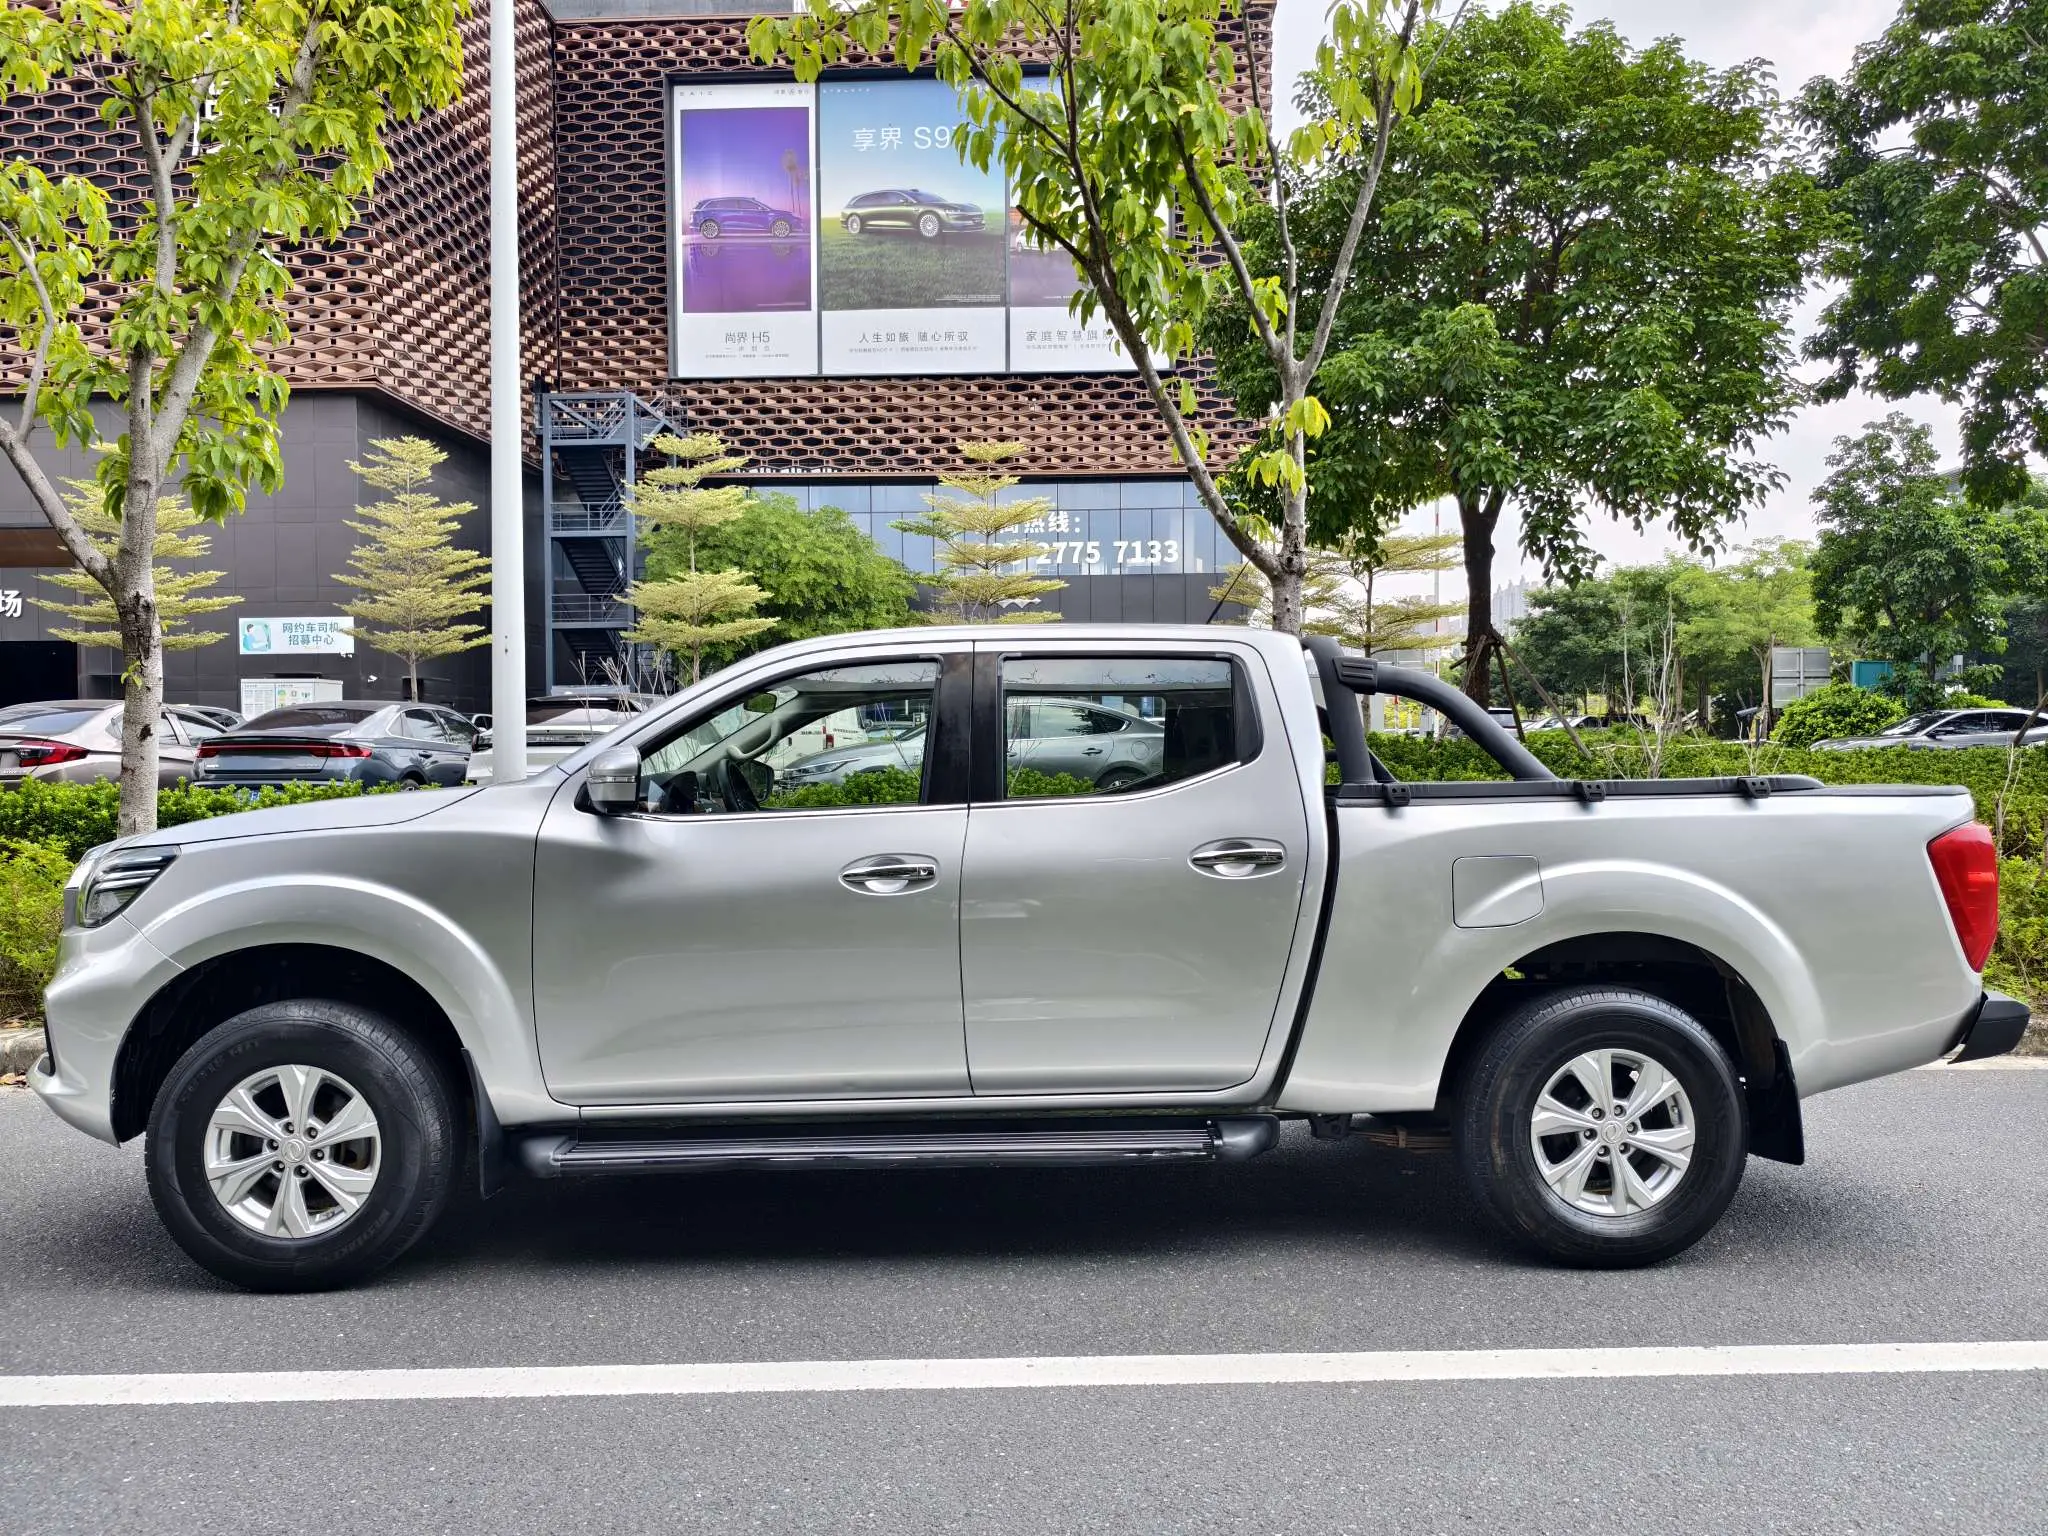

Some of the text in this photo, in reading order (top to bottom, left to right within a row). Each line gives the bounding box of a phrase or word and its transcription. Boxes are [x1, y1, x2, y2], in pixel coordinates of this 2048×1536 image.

[852, 127, 903, 151] 享界
[725, 330, 771, 344] 尚界 H5
[859, 330, 968, 343] 人生如旅 随心所驭
[1036, 540, 1101, 564] 2775
[1112, 539, 1179, 563] 7133
[0, 589, 22, 618] 场
[282, 621, 339, 634] 网约车司机
[288, 634, 334, 646] 招募中心
